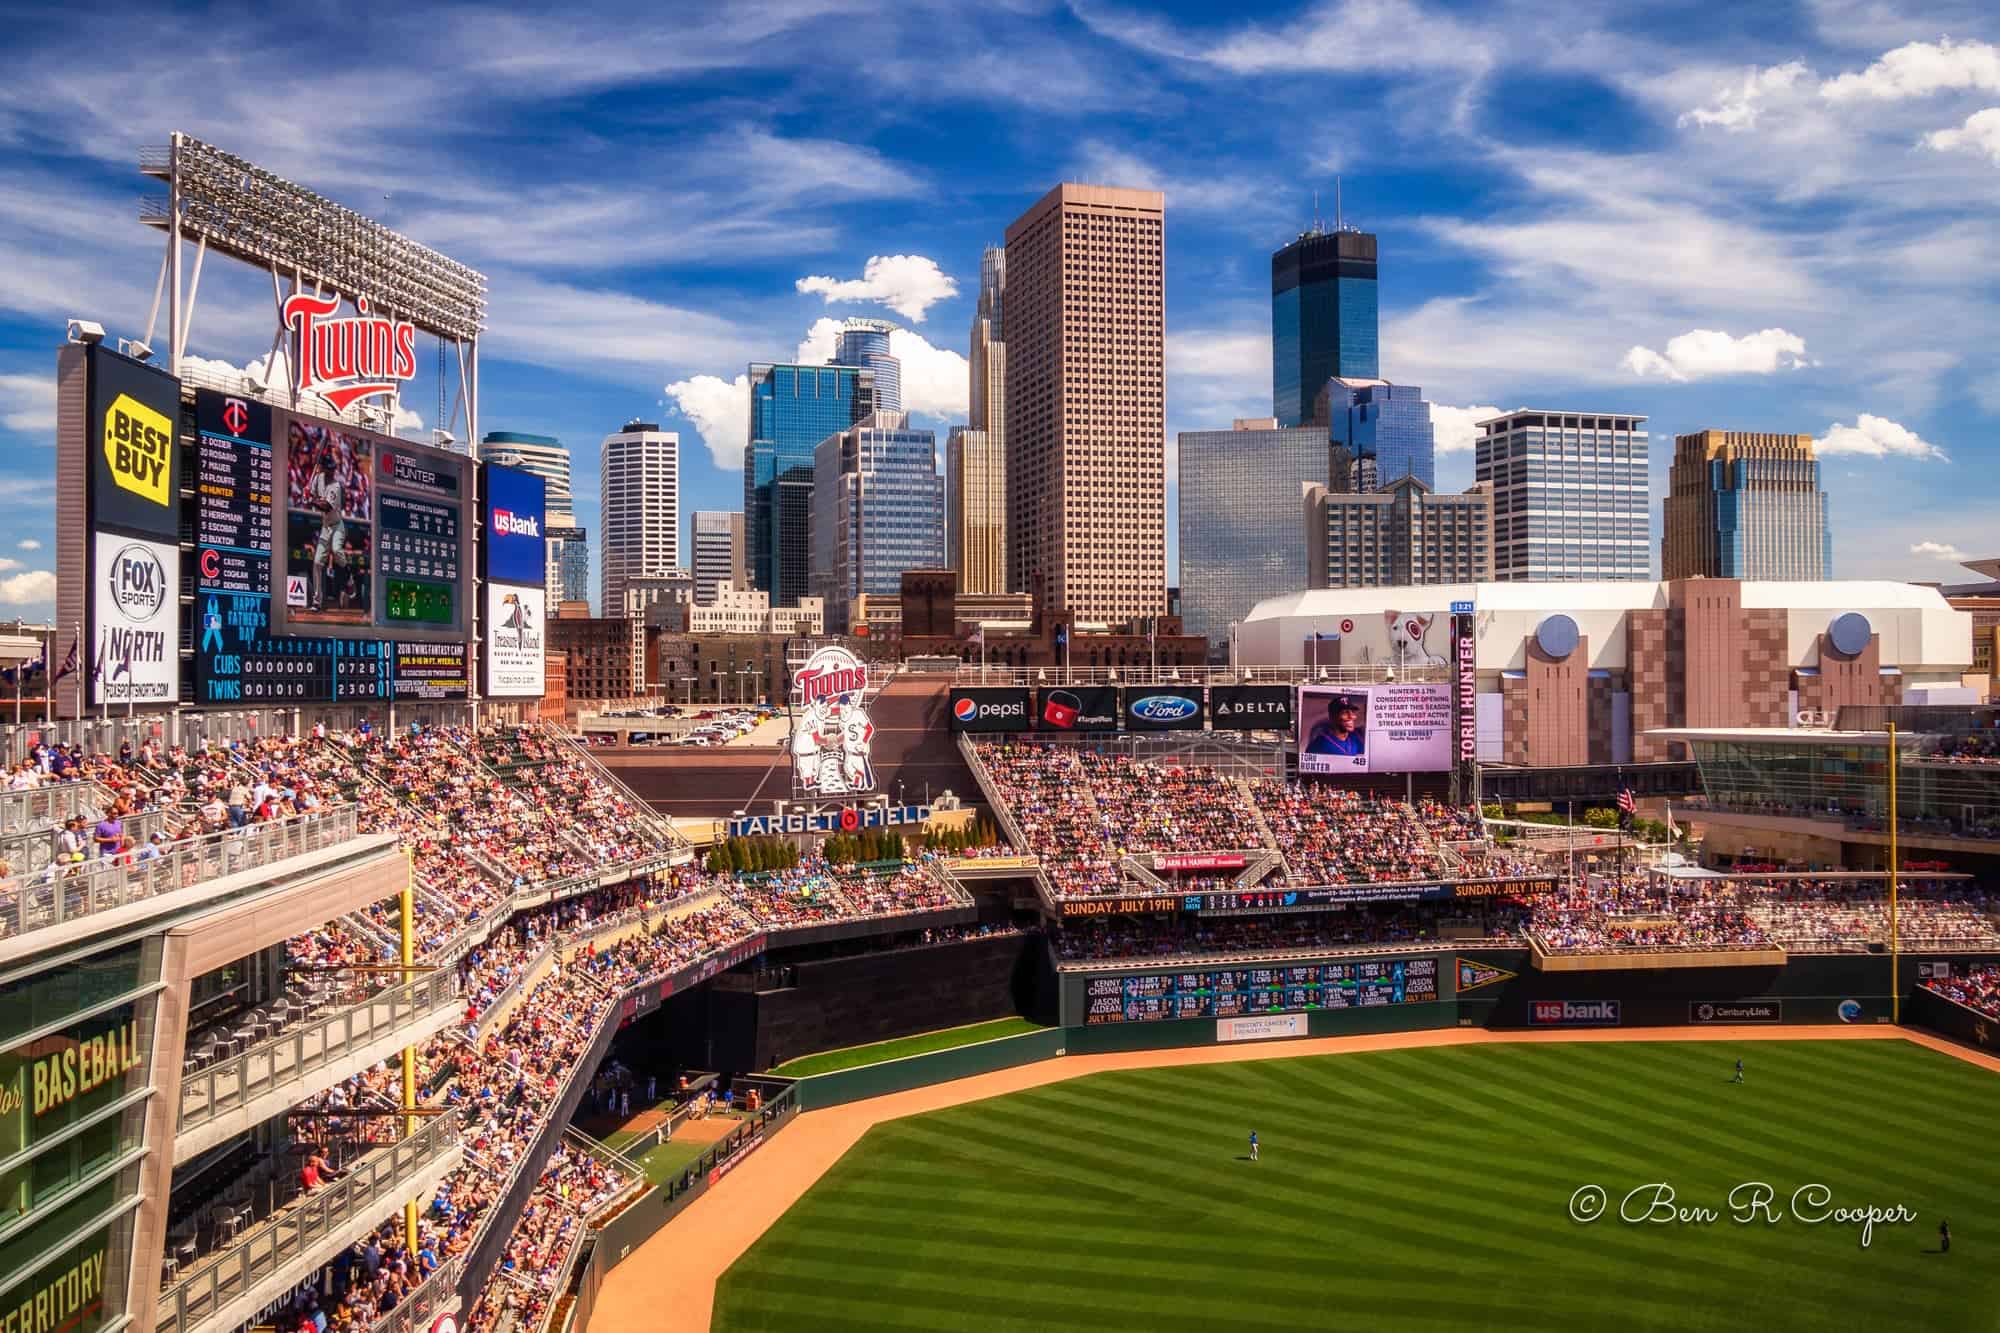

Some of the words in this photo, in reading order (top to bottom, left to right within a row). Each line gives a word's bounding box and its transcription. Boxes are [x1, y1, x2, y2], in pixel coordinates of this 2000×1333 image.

[282, 290, 417, 393] Twins
[114, 408, 169, 461] BEST
[115, 440, 165, 488] BUY
[394, 465, 436, 484] HUNTER
[208, 486, 234, 498] HUNTER
[208, 535, 235, 546] BUXTON
[121, 558, 154, 594] FOX
[121, 591, 156, 607] SPORTS
[232, 595, 262, 612] HAPPY
[239, 625, 257, 641] DAY
[493, 630, 518, 649] Treasure
[523, 631, 540, 649] Island
[109, 626, 165, 663] NORTH
[428, 644, 451, 657] FANTASY
[451, 645, 465, 657] CAMP
[214, 654, 241, 674] CUBS
[1460, 636, 1475, 708] HUNTER
[207, 679, 241, 700] TWINS
[795, 663, 867, 706] Twins
[979, 701, 1024, 719] pepsi
[1143, 699, 1185, 717] Ford
[1234, 703, 1286, 714] DELTA
[1460, 714, 1475, 761] TORII
[729, 812, 838, 837] TARGET
[860, 805, 932, 827] FIELD
[1455, 884, 1501, 897] SUNDAY,
[1503, 883, 1527, 895] JULY
[1529, 881, 1553, 894] 19TH
[1063, 901, 1116, 915] SUNDAY,
[1119, 900, 1146, 913] JULY
[1149, 898, 1175, 911] 19TH
[1087, 986, 1122, 996] CHESNEY
[1094, 978, 1121, 989] KENNY
[1405, 985, 1434, 993] ALDEAN
[1089, 1005, 1121, 1014] ALDEAN
[1094, 997, 1120, 1007] JASON
[1717, 1006, 1771, 1018] CenturyLink
[33, 1020, 143, 1115] BASEBALL
